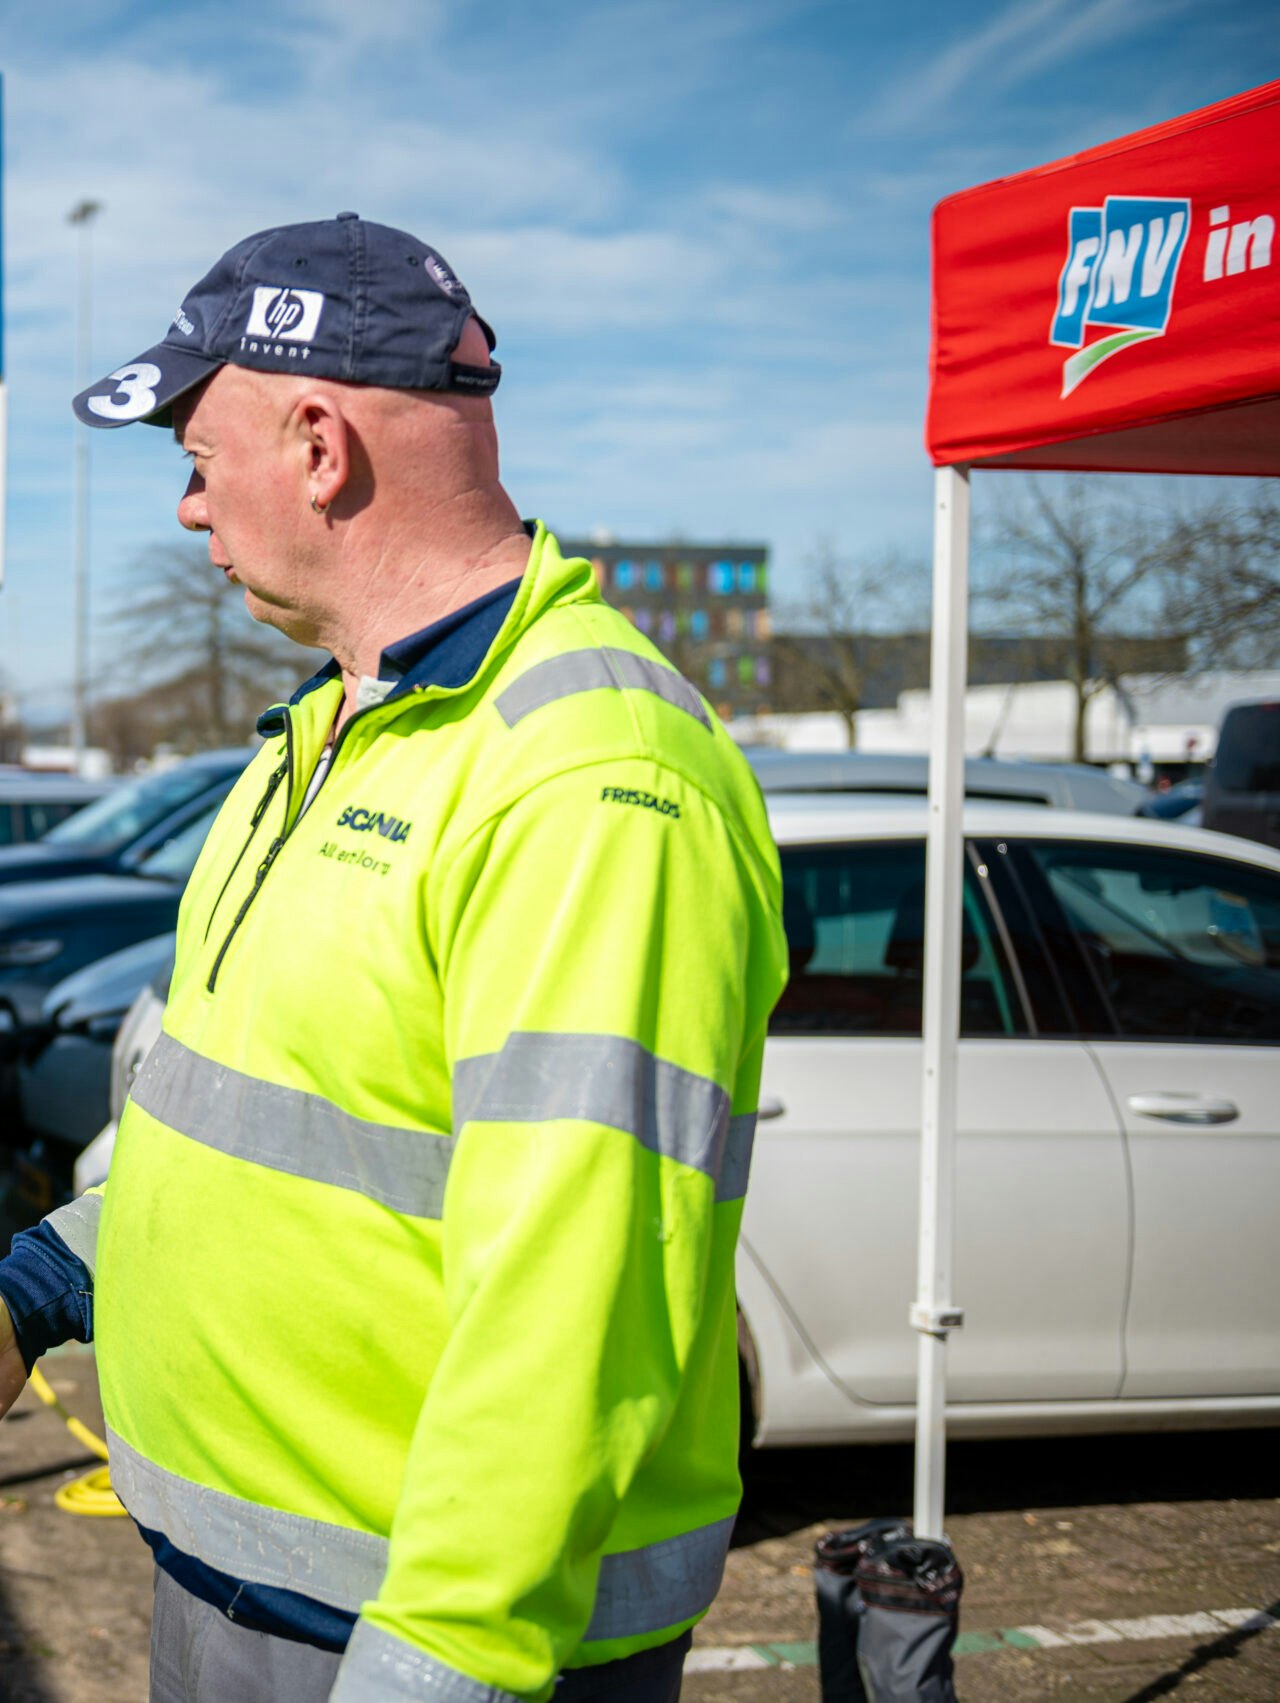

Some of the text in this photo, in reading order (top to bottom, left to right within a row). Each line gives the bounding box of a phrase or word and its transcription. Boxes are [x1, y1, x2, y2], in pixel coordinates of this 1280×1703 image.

[1060, 204, 1275, 317] FNV in
[267, 288, 301, 339] hp
[240, 336, 311, 360] invent
[87, 362, 162, 420] 3
[336, 805, 412, 844] SCANIA
[601, 786, 680, 819] FRISTADS
